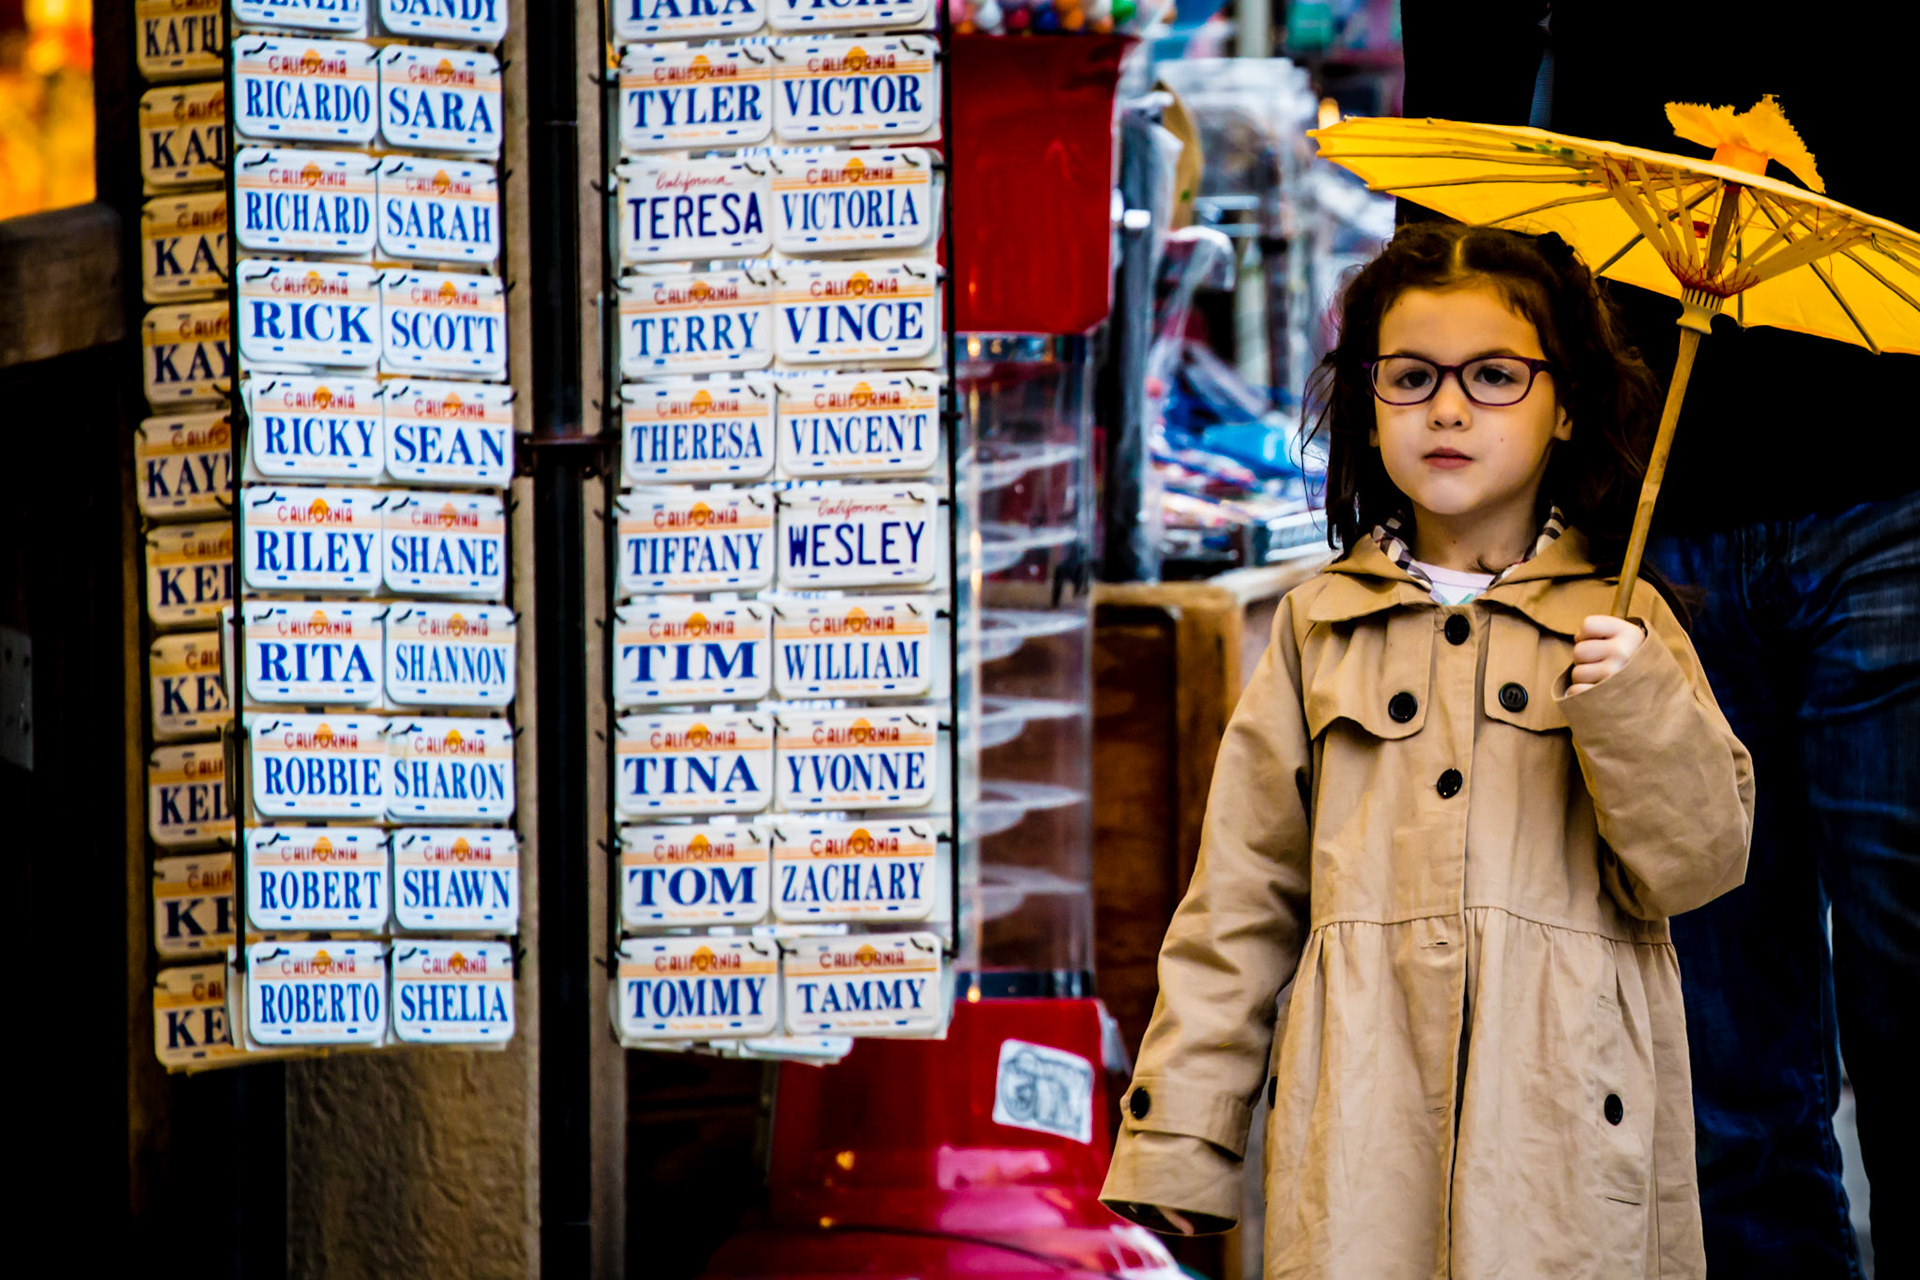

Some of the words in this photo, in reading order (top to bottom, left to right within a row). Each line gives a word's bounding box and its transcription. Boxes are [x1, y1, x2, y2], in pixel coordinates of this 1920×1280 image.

[269, 56, 346, 76] CALIFORNIA
[408, 65, 475, 86] CALIFORNIA
[654, 64, 738, 84] CALIFORNIA
[808, 54, 896, 73] CALIFORNIA
[246, 79, 371, 124] RICARDO
[389, 87, 493, 133] SARA
[629, 84, 762, 128] TYLER
[783, 74, 922, 116] VICTOR
[269, 168, 346, 187] CALIFORNIA
[405, 176, 471, 195] CALIFORNIA
[656, 171, 734, 191] California
[806, 168, 894, 185] CALIFORNIA
[246, 192, 370, 234] RICHARD
[387, 200, 491, 244] SARAH
[628, 192, 763, 241] TERESA
[781, 188, 919, 230] VICTORIA
[154, 233, 228, 277] KA
[271, 277, 349, 296] CALIFORNIA
[410, 287, 478, 306] CALIFORNIA
[654, 286, 738, 306] CALIFORNIA
[810, 278, 898, 298] CALIFORNIA
[253, 301, 373, 344] RICK
[392, 311, 498, 353] SCOTT
[632, 311, 759, 356] TERRY
[784, 302, 923, 344] VINCE
[283, 392, 355, 410] CALIFORNIA
[415, 399, 484, 418] CALIFORNIA
[657, 399, 739, 417] CALIFORNIA
[814, 391, 900, 410] CALIFORNIA
[264, 416, 376, 458] RICKY
[394, 424, 505, 467] SEAN
[632, 421, 763, 464] THERESA
[790, 414, 928, 455] VINCENT
[277, 504, 353, 523] CALIFORNIA
[412, 510, 478, 528] CALIFORNIA
[653, 509, 738, 529] CALIFORNIA
[818, 499, 896, 520] California
[256, 530, 374, 574] RILEY
[391, 535, 499, 576] SHANE
[628, 533, 763, 576] TIFFANY
[788, 521, 926, 567] WESLEY
[277, 618, 352, 636] CALIFORNIA
[418, 619, 489, 637] CALIFORNIA
[649, 621, 734, 639] CALIFORNIA
[809, 616, 894, 635] CALIFORNIA
[258, 642, 374, 683] RITA
[395, 644, 506, 685] SHANNON
[623, 641, 759, 682] TIM
[784, 641, 920, 681] WILLIAM
[284, 732, 358, 749] CALIFORNIA
[415, 736, 485, 755] CALIFORNIA
[650, 731, 736, 750] CALIFORNIA
[812, 727, 899, 745] CALIFORNIA
[264, 757, 383, 796] ROBBIE
[394, 760, 505, 800] SHARON
[624, 755, 759, 795] TINA
[788, 751, 926, 793] YVONNE
[282, 846, 357, 862] CALIFORNIA
[424, 846, 492, 862] CALIFORNIA
[654, 843, 734, 861] CALIFORNIA
[810, 838, 898, 856] CALIFORNIA
[259, 871, 381, 910] ROBERT
[403, 869, 511, 909] SHAWN
[629, 866, 757, 907] TOM
[781, 862, 924, 902] ZACHARY
[282, 959, 356, 975] CALIFORNIA
[422, 958, 488, 974] CALIFORNIA
[655, 952, 741, 972] CALIFORNIA
[819, 952, 905, 969] CALIFORNIA
[260, 983, 380, 1025] ROBERTO
[401, 985, 508, 1022] SHELIA
[628, 977, 766, 1019] TOMMY
[797, 978, 926, 1014] TAMMY
